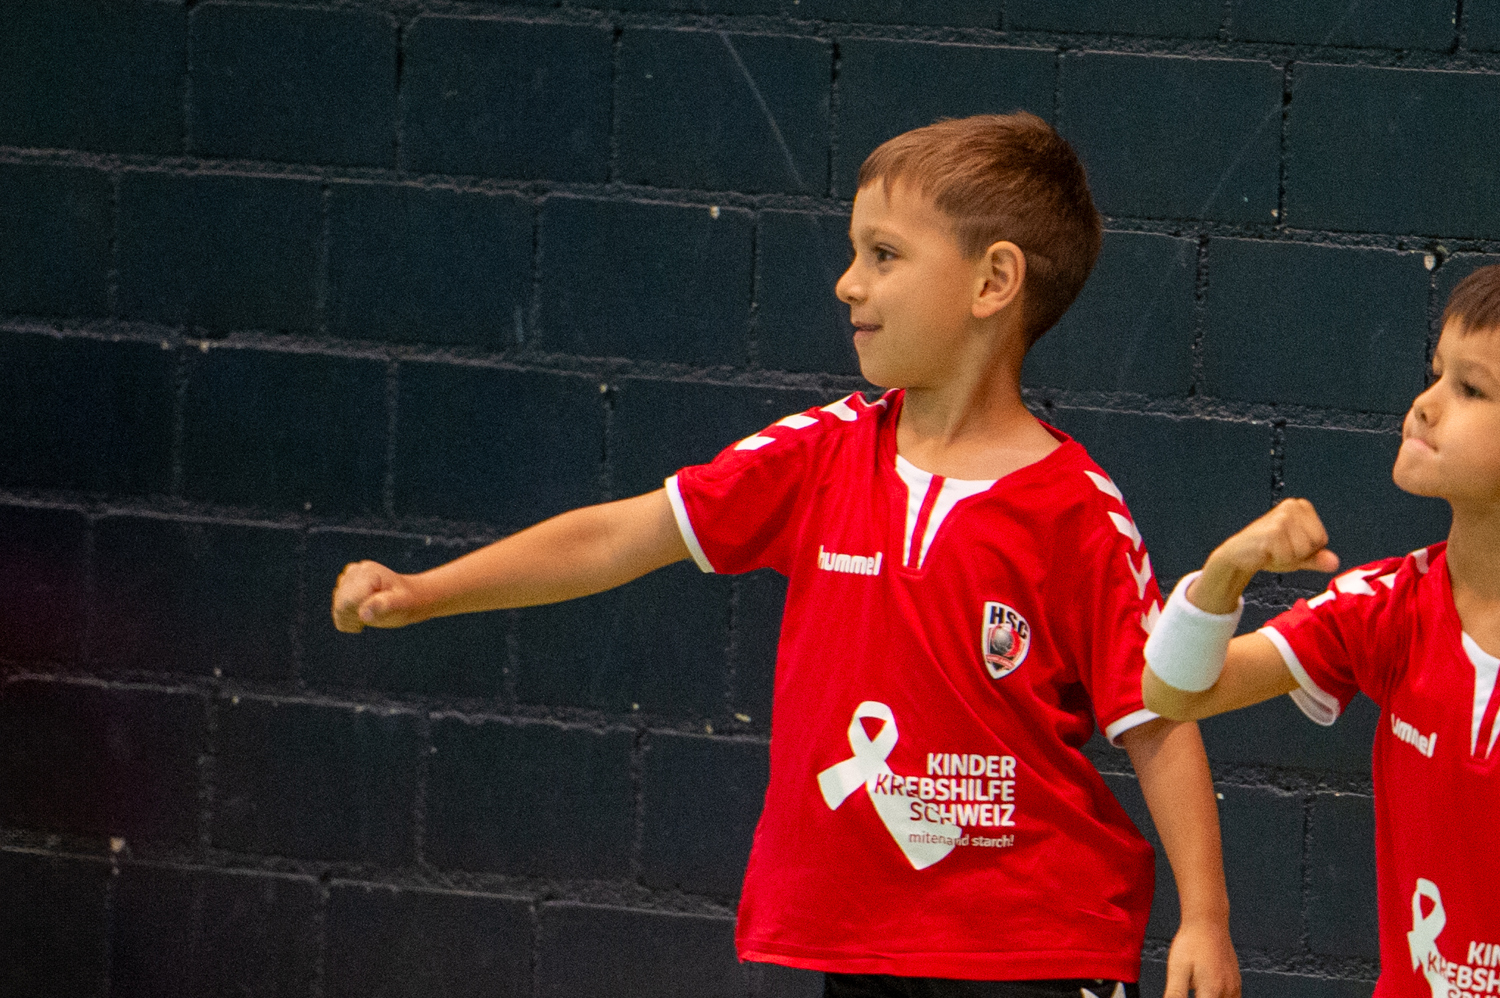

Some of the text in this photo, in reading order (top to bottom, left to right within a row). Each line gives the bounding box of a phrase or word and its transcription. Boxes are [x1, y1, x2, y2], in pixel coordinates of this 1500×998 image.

[817, 544, 883, 576] hummel
[989, 605, 1029, 639] HSC
[927, 752, 1017, 778] KINDER
[874, 773, 1016, 801] KREBSHILFE
[909, 801, 1016, 827] SCHWEIZ
[972, 834, 1014, 848] starch!
